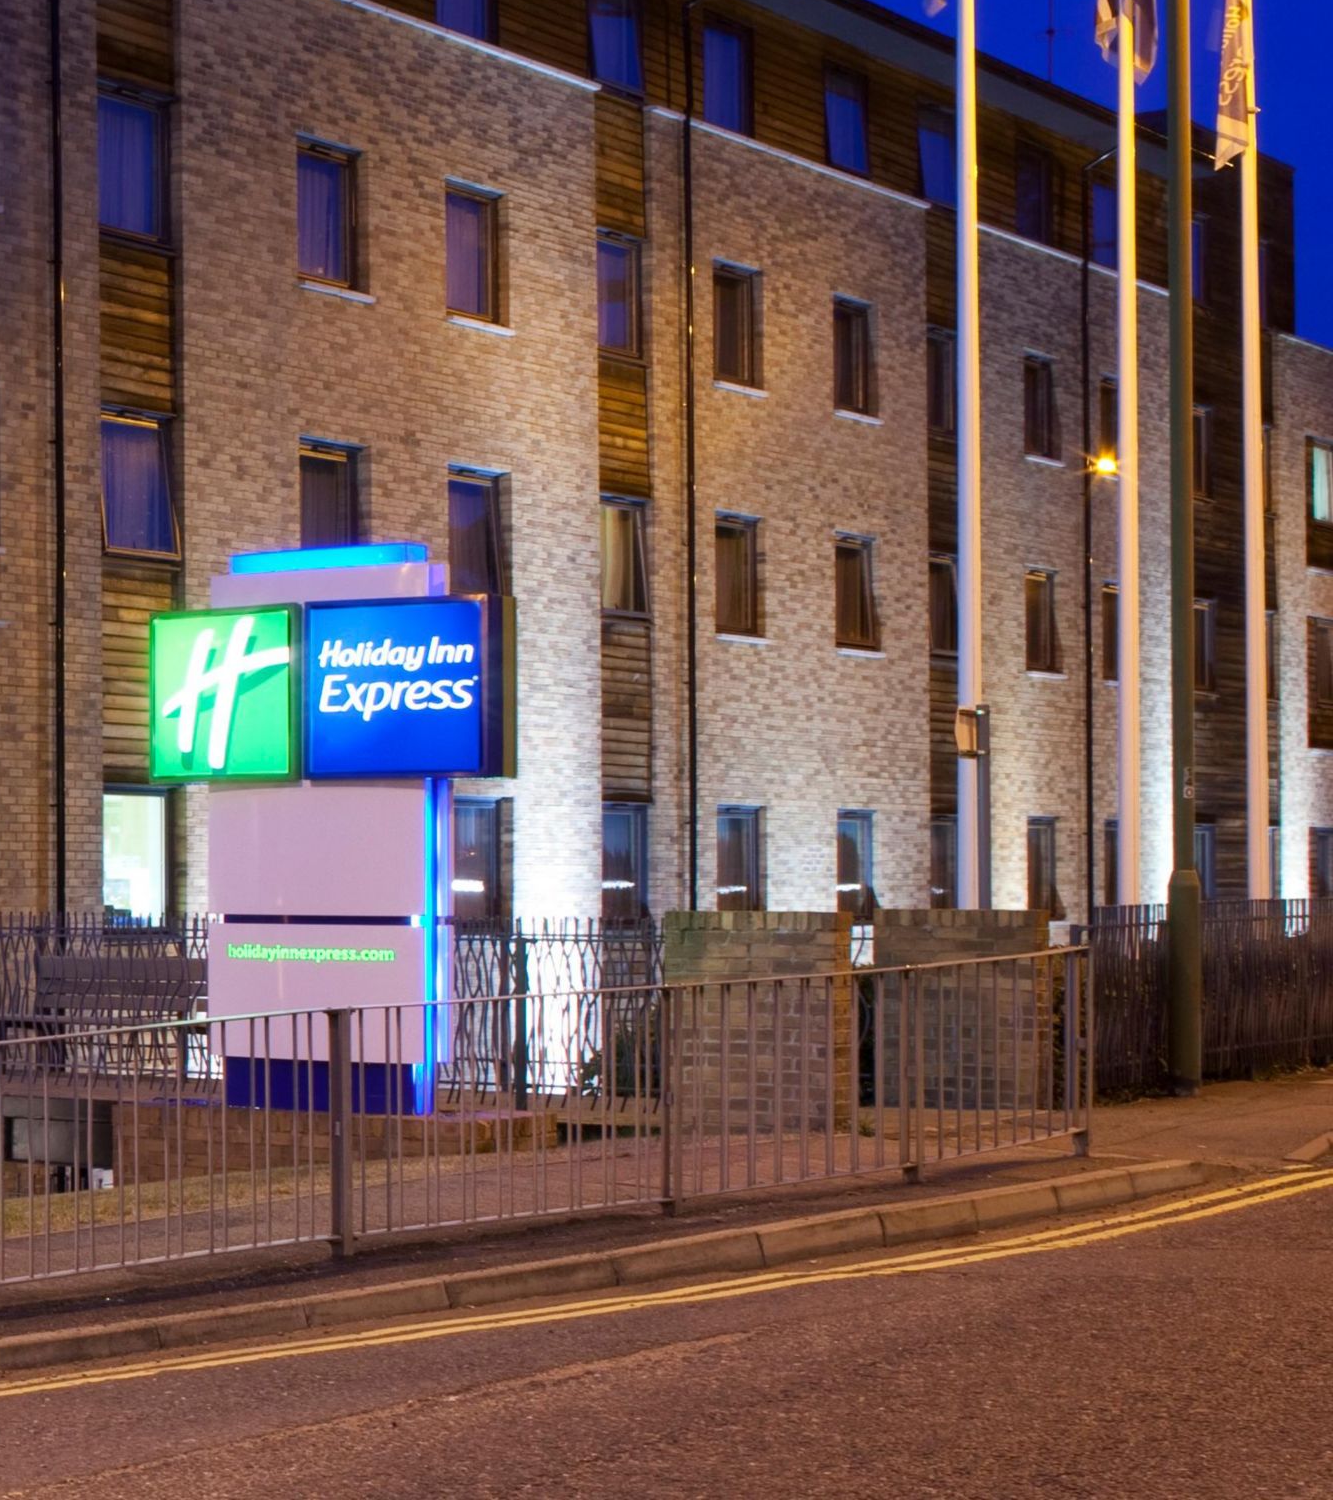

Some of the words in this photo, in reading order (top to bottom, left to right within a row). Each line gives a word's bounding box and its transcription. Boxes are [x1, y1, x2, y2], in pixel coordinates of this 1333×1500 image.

[318, 638, 425, 672] Holiday
[427, 636, 474, 664] Inn
[319, 674, 474, 722] Express
[227, 943, 396, 963] holidayinnexpress.com
